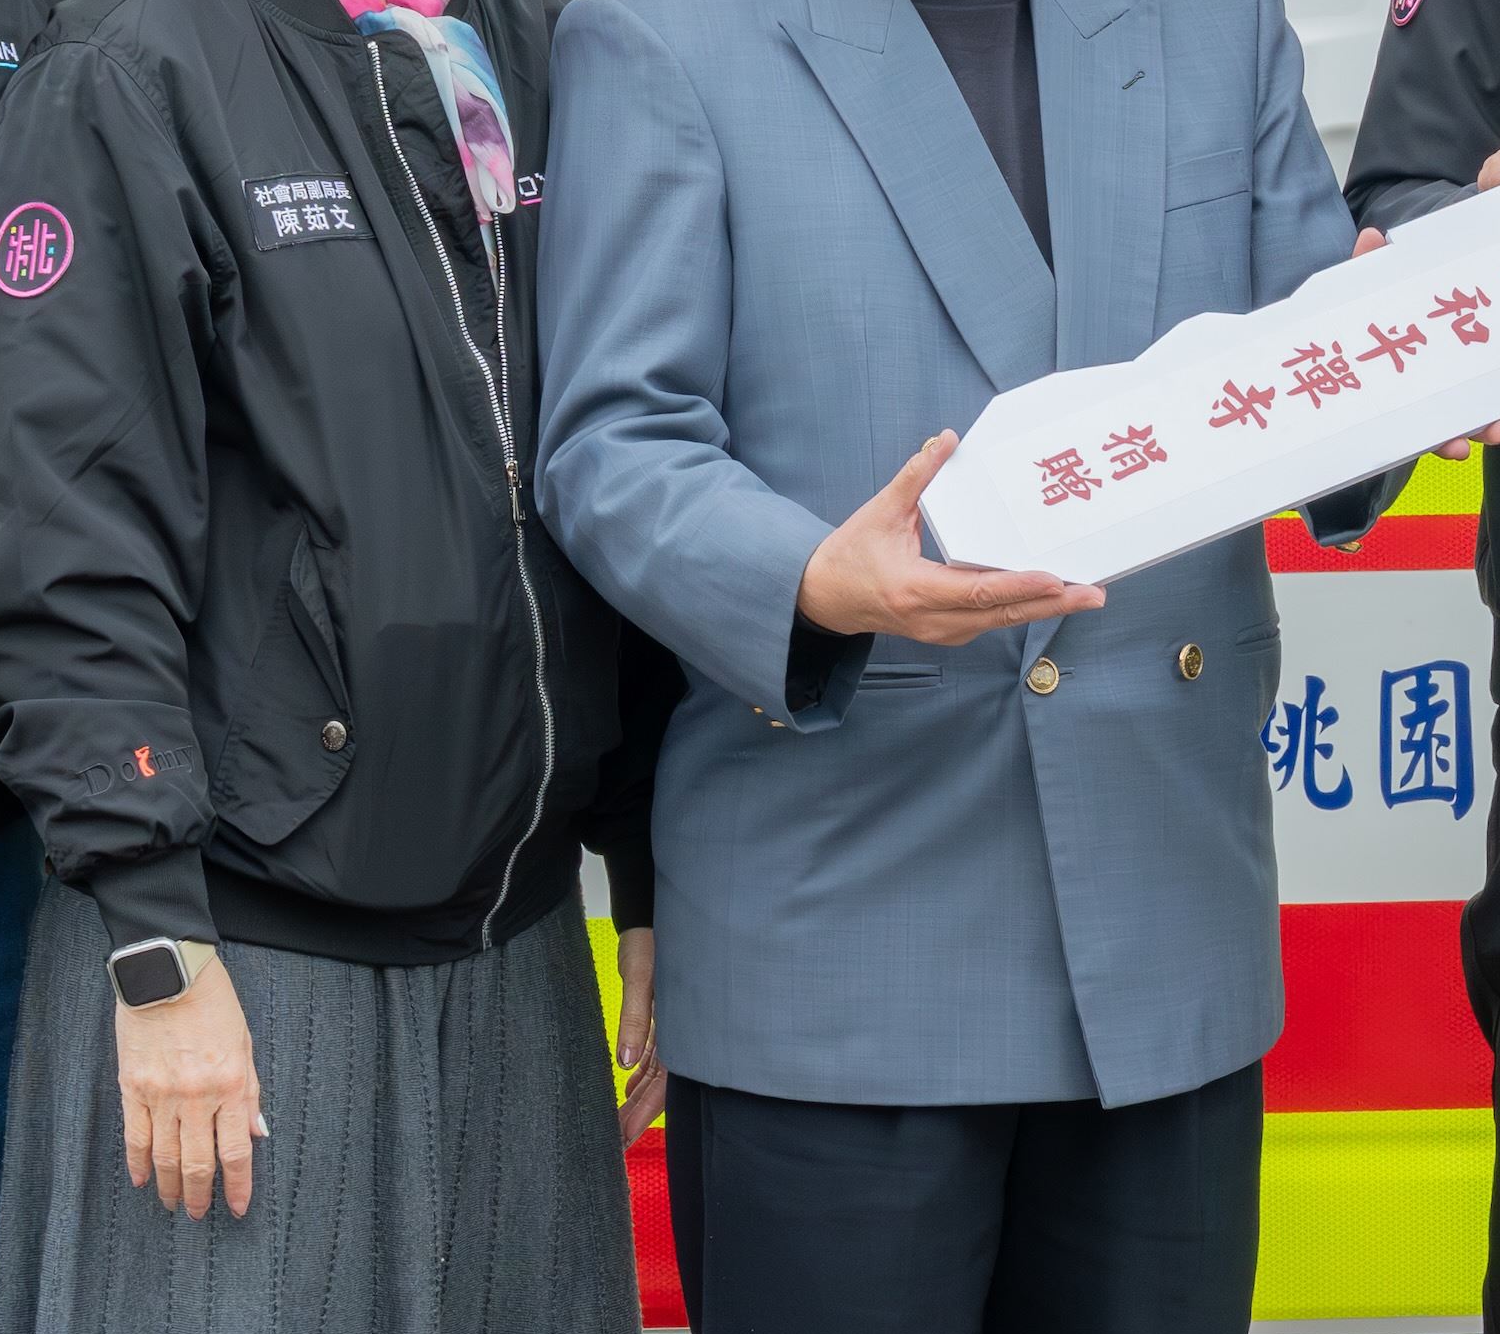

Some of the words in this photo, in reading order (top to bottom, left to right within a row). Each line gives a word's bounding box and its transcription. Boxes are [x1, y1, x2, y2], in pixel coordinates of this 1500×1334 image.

[253, 179, 352, 208] 社會局副局長
[271, 203, 356, 238] 陳茹文
